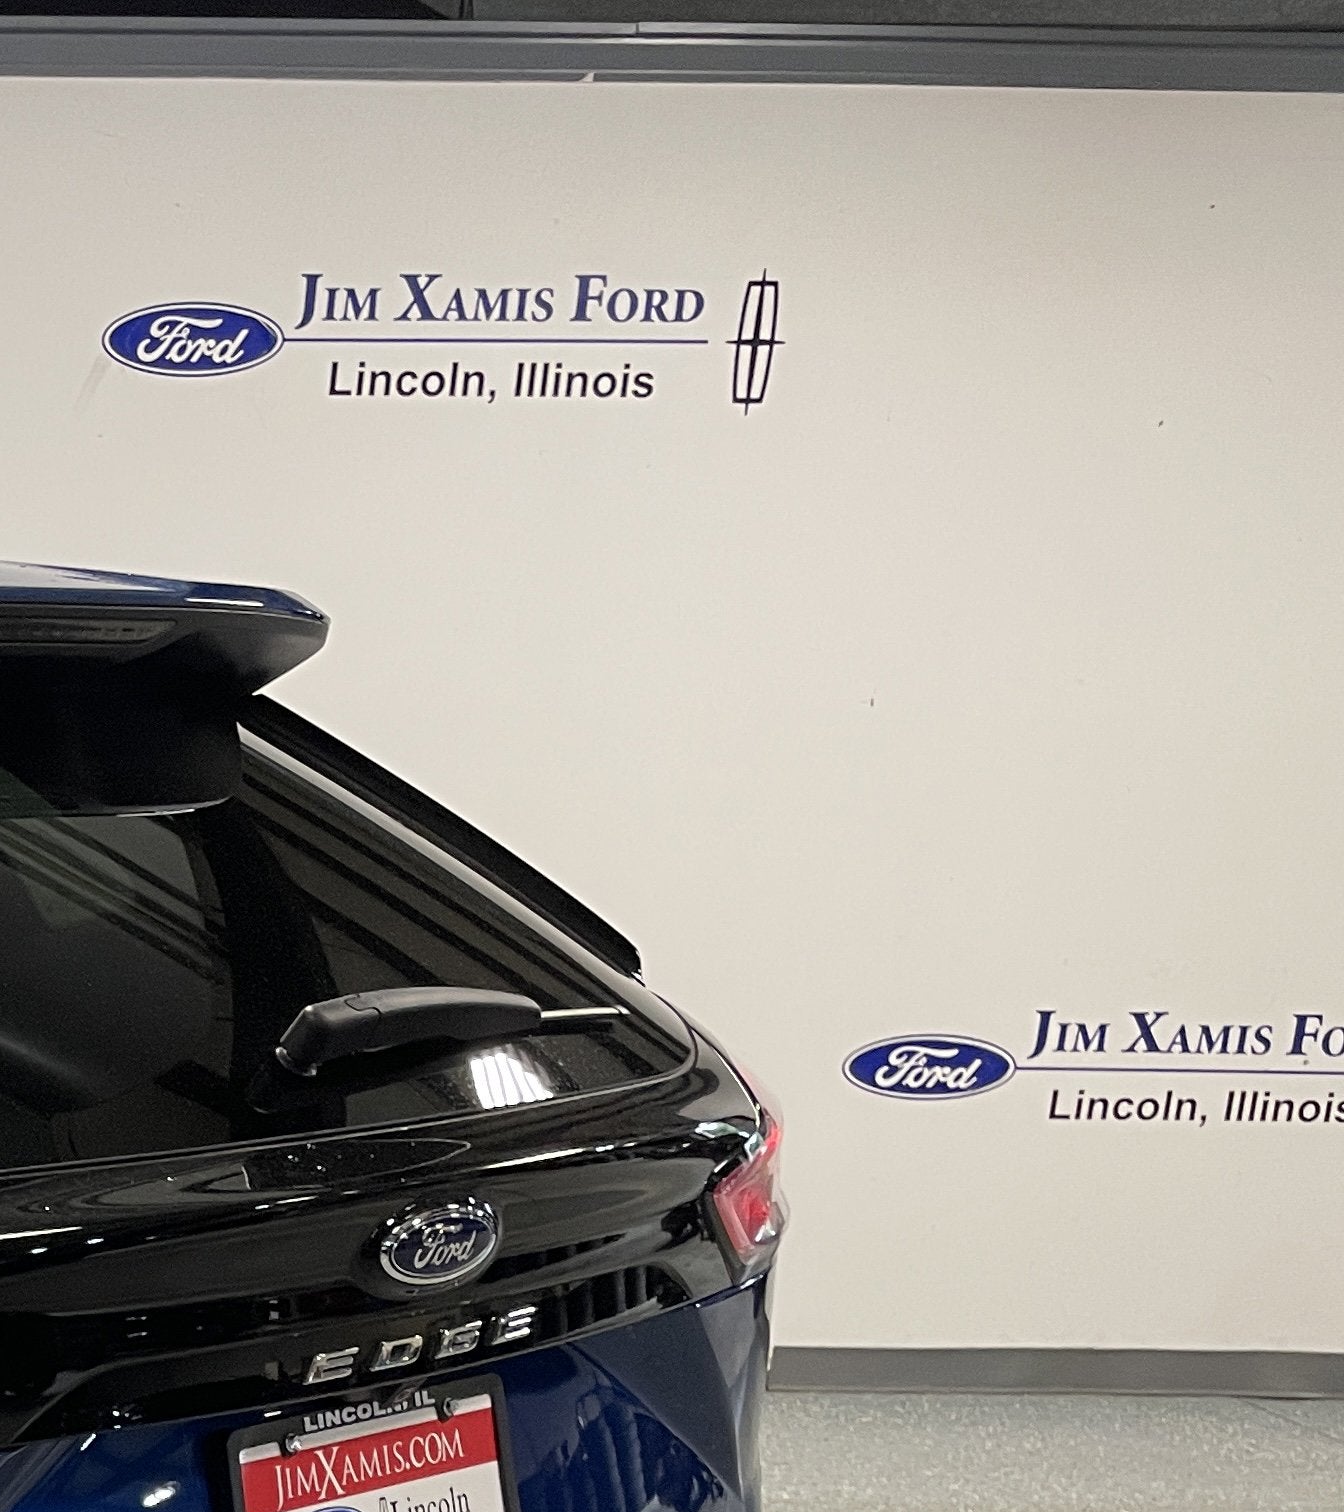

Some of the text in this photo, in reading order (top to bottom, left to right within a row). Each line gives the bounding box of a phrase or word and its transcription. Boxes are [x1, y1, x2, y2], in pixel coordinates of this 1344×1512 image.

[295, 273, 705, 330] JIM XAMIS FORD
[137, 315, 245, 365] Ford
[328, 360, 655, 404] Lincoln, Illinois
[1027, 1009, 1344, 1060] JIM XAMIS FO
[874, 1044, 979, 1091] Ford
[1048, 1088, 1207, 1128] Lincoln,
[302, 1305, 538, 1386] EDGE
[414, 1390, 435, 1408] IL
